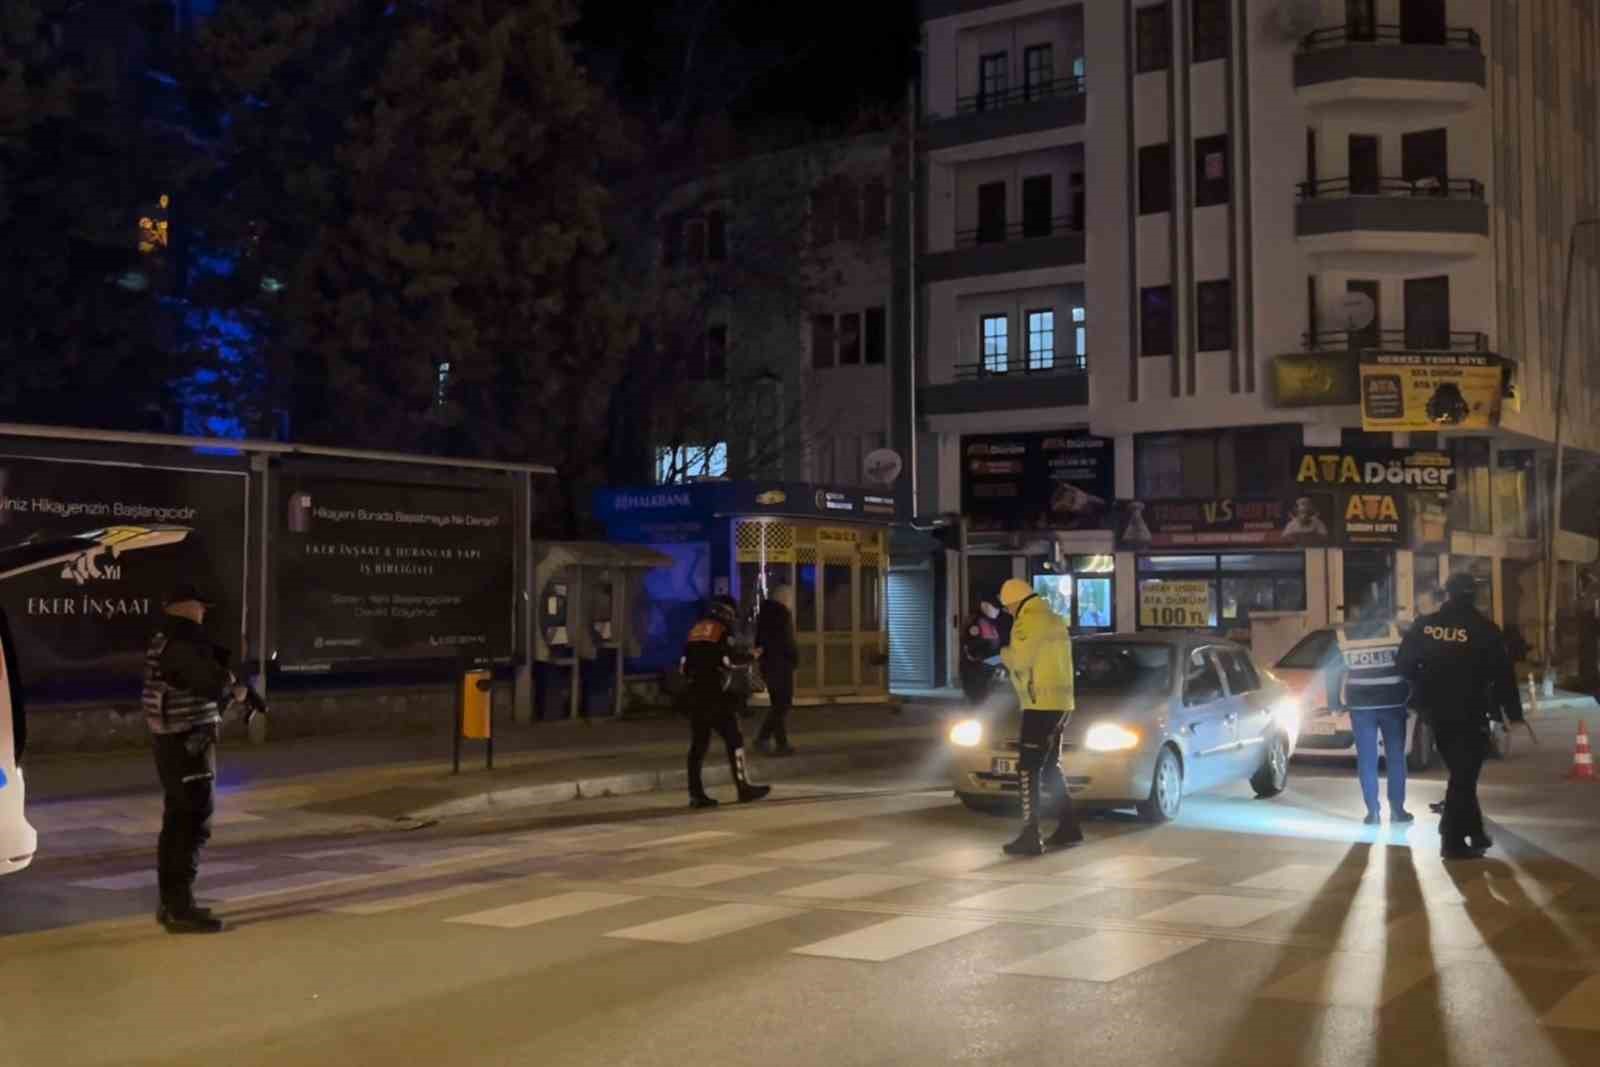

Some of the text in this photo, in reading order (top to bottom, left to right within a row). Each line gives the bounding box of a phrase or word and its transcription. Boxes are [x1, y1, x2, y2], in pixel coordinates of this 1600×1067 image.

[1296, 453, 1361, 484] ATA
[1364, 458, 1456, 484] Döner
[629, 493, 690, 507] HALKBANK
[1202, 498, 1234, 525] VS
[1345, 494, 1400, 520] ATA
[27, 593, 151, 621] EKER İNŞAAT
[1152, 607, 1206, 625] 100 TL
